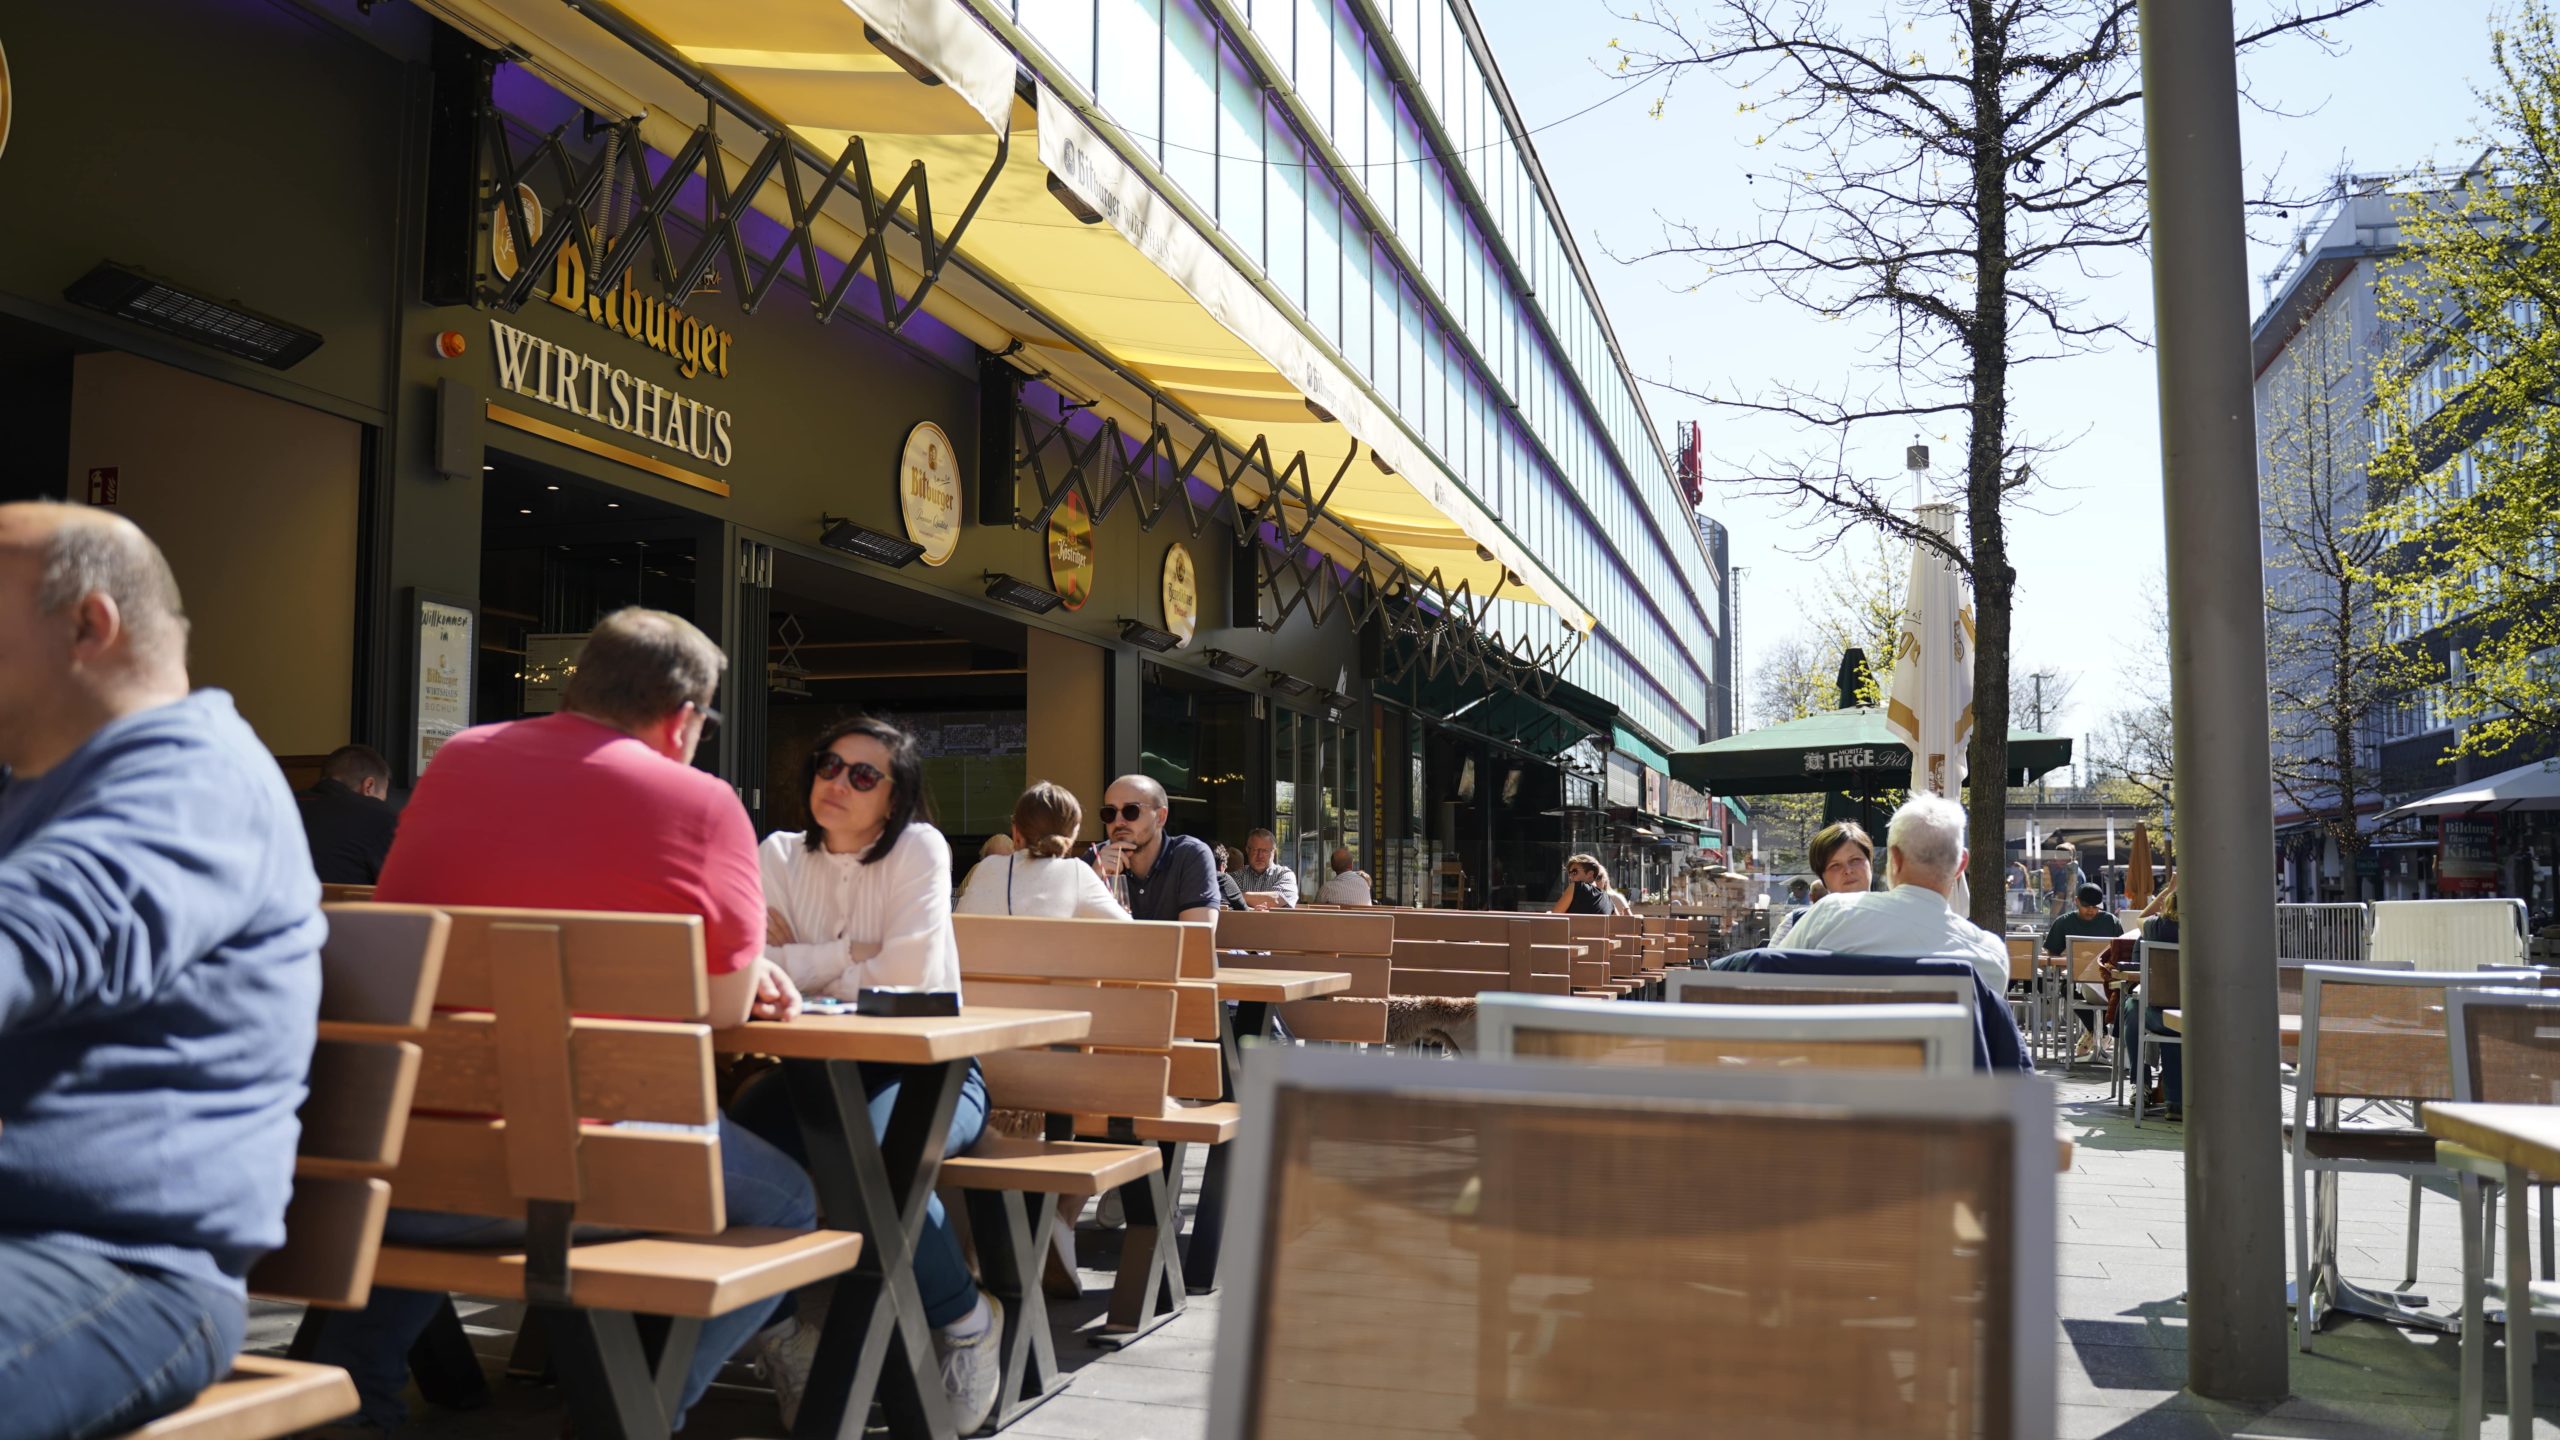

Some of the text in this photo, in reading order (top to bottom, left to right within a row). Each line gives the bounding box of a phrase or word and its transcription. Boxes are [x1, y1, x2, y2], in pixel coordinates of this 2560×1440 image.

[1077, 148, 1120, 218] Bitburger
[490, 318, 732, 467] WIRTSHAUS
[910, 465, 954, 512] Bitburger
[421, 609, 468, 628] Willkommen
[1828, 748, 1911, 770] FIEGE Pils
[1839, 747, 1863, 756] MORITZ
[2445, 822, 2495, 836] Bildung
